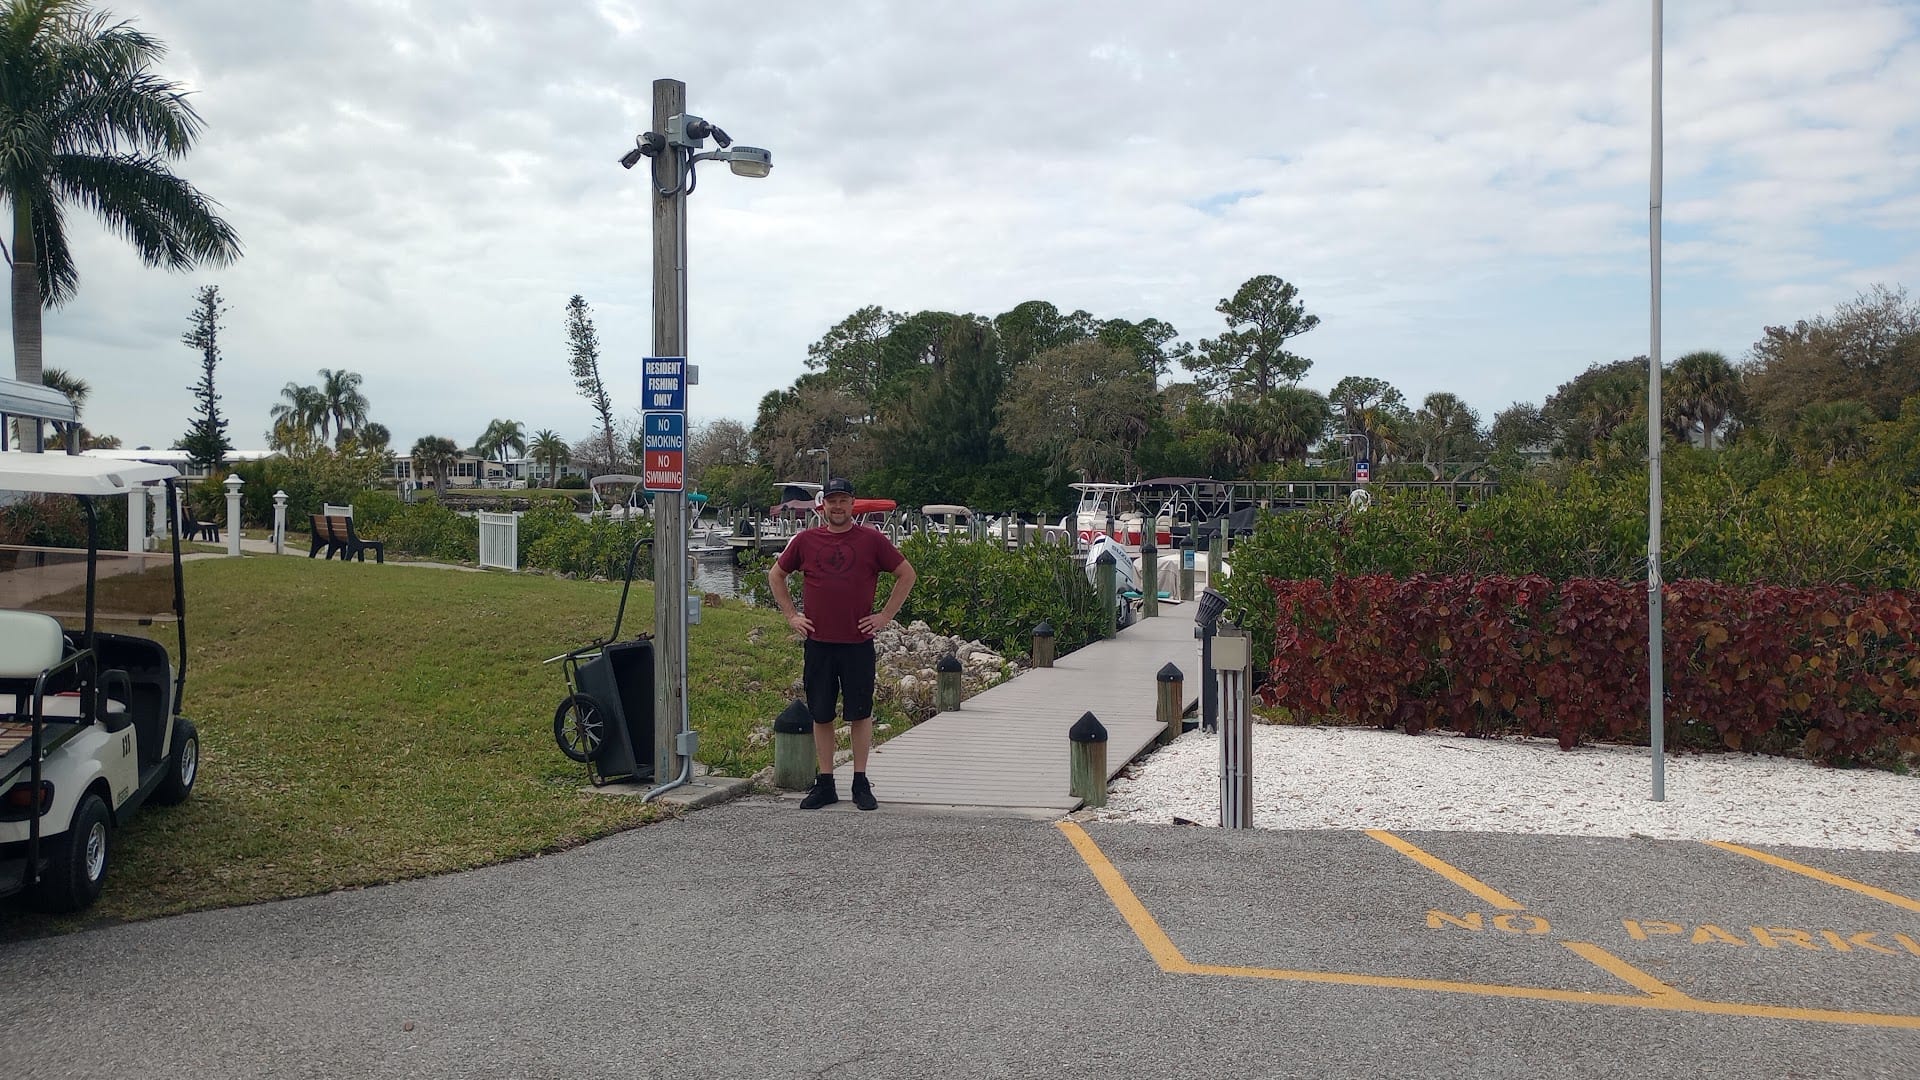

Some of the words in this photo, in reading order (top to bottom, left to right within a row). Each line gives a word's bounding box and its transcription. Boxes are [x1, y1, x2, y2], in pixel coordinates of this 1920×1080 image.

[646, 362, 681, 374] RESIDENT
[648, 378, 678, 390] FISHING
[654, 394, 672, 406] ONLY
[658, 419, 670, 431] NO
[646, 435, 682, 448] SMOKING
[658, 456, 670, 467] NO
[646, 471, 682, 484] SWIMMING
[1425, 910, 1551, 934] NO
